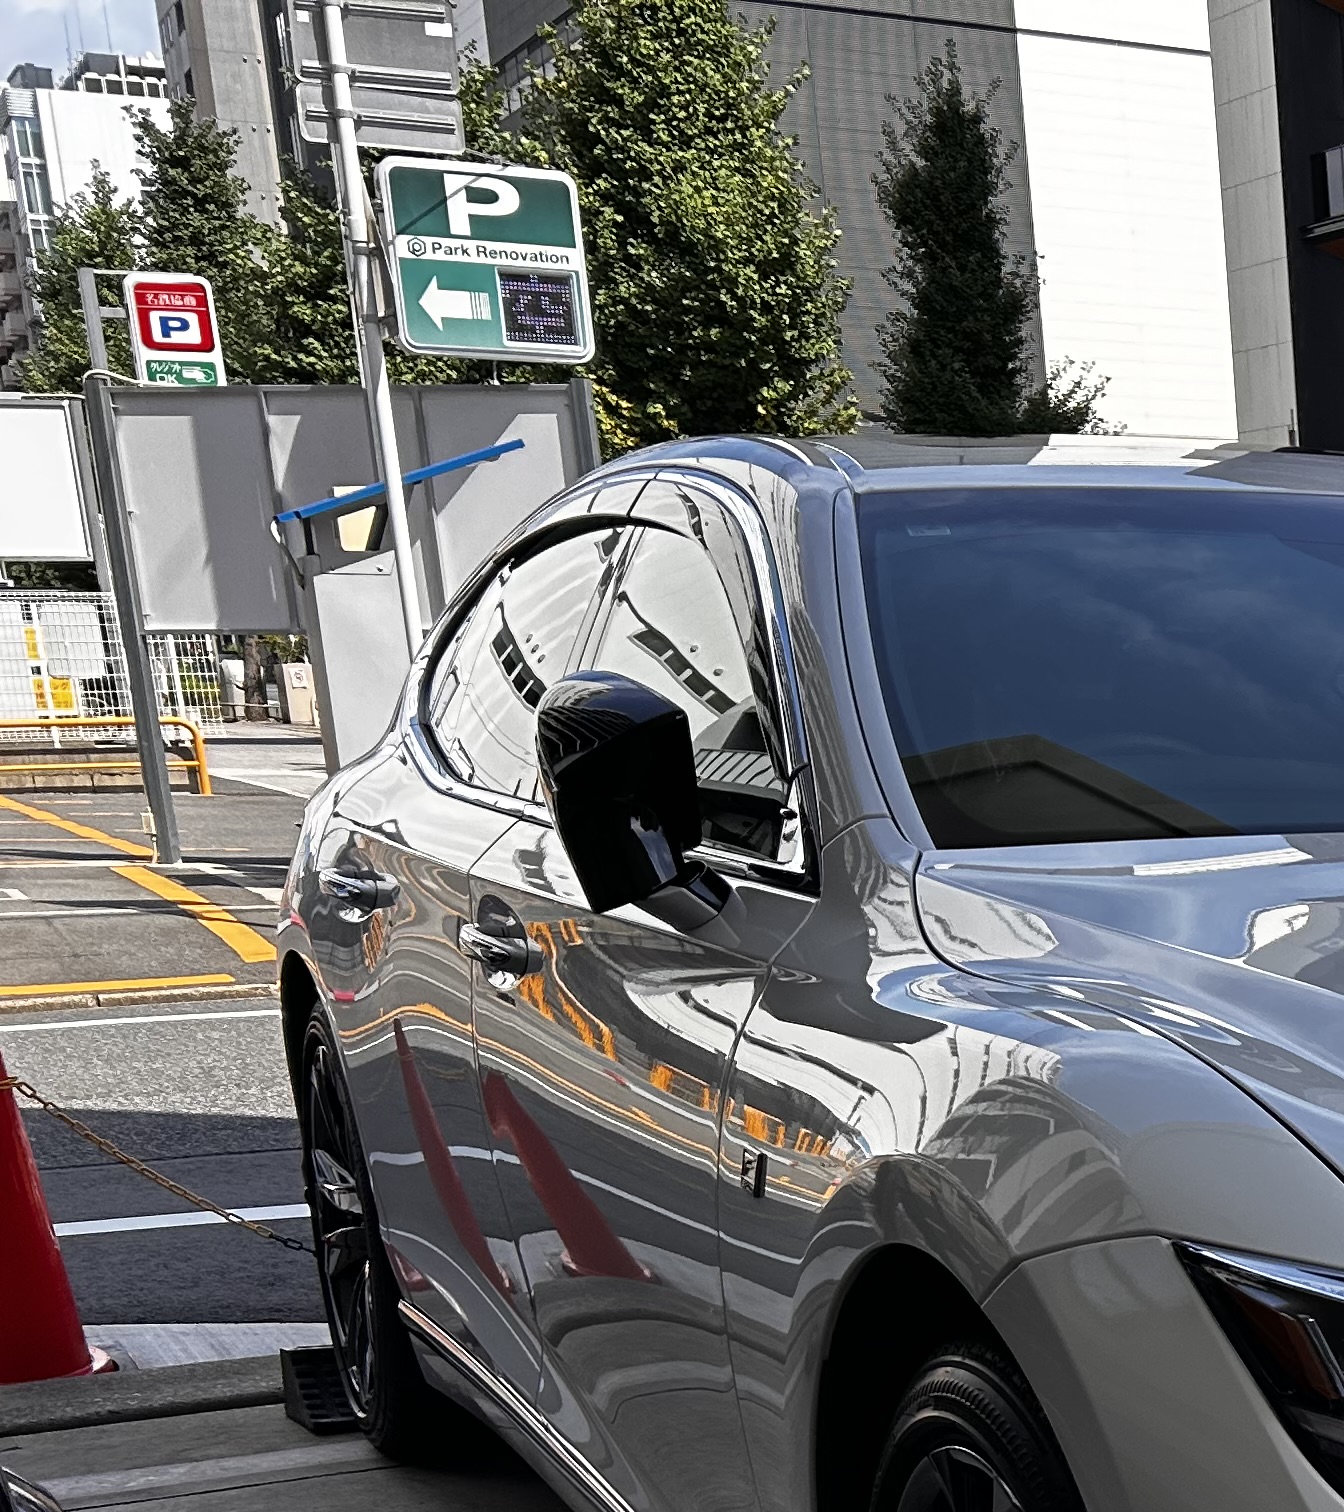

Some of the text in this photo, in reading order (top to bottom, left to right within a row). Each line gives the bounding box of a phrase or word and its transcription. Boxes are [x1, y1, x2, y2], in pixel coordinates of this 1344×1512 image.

[443, 172, 521, 237] P
[431, 241, 570, 265] Park Renovation
[158, 315, 191, 339] P
[155, 373, 179, 385] OK
